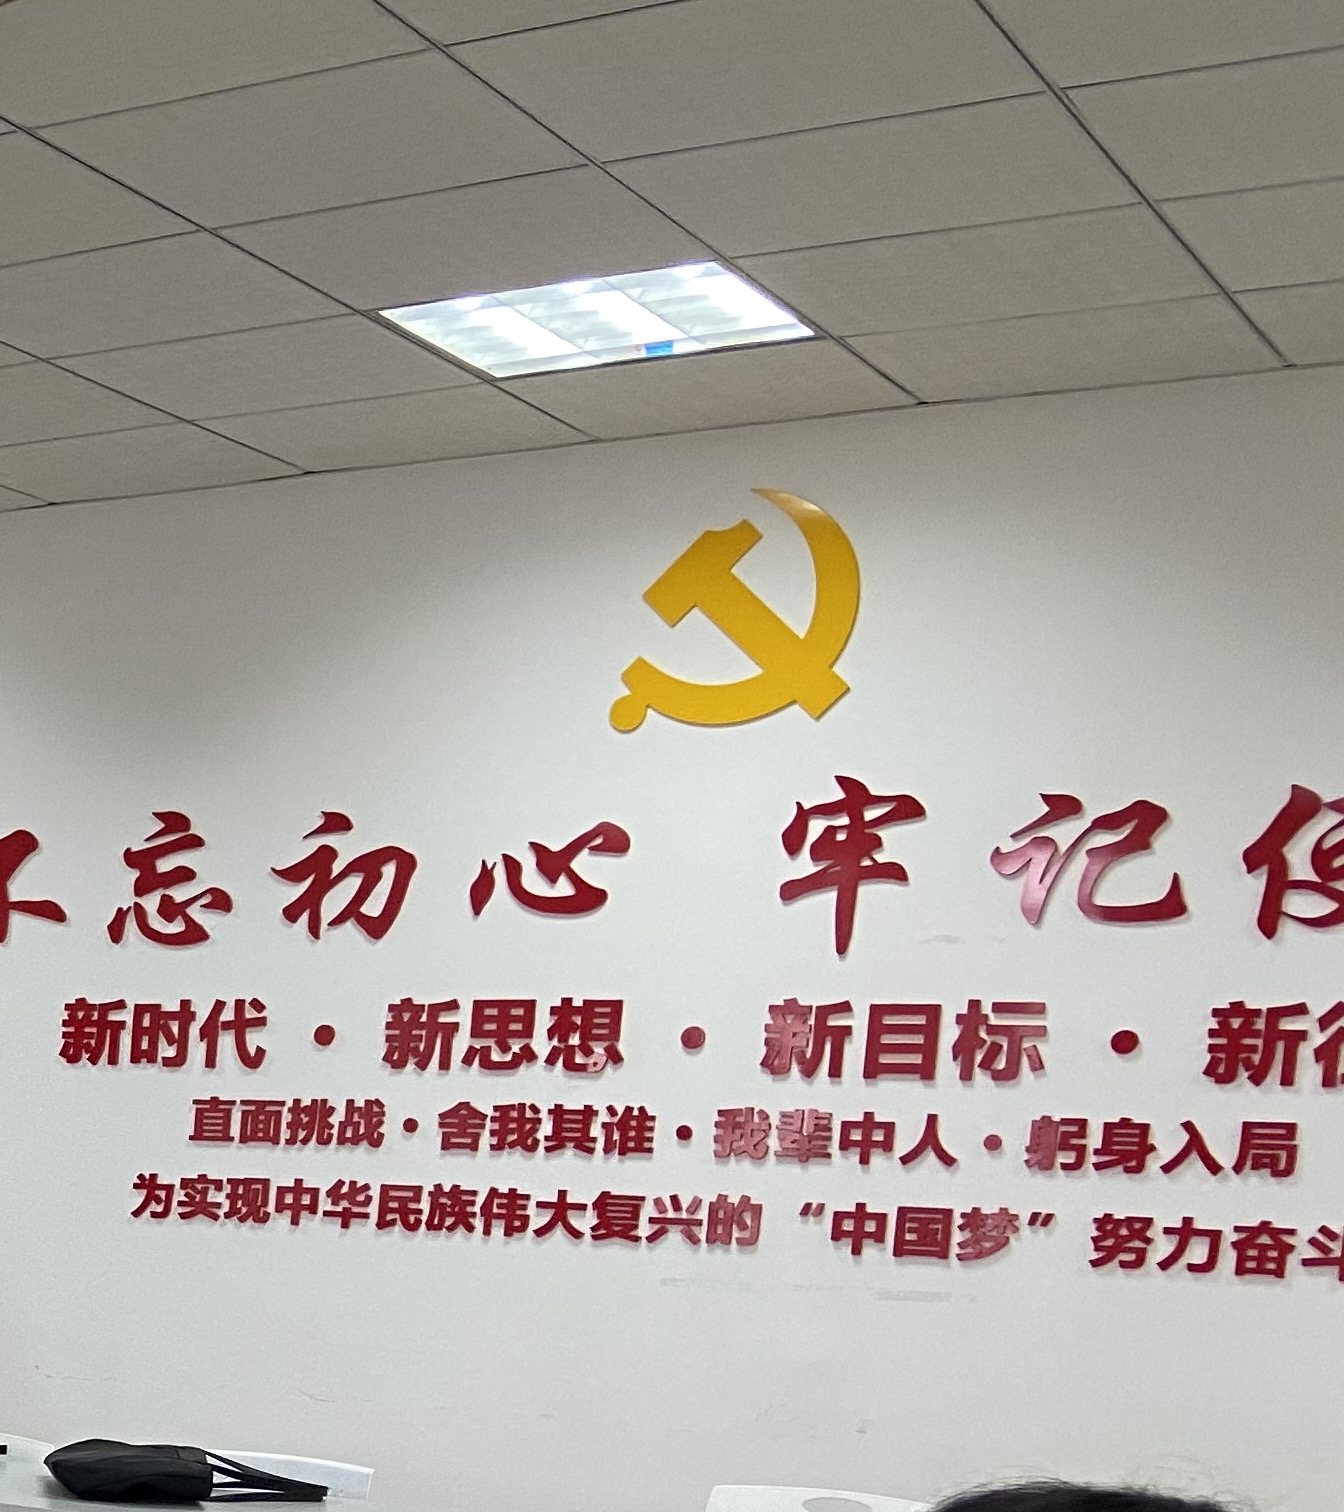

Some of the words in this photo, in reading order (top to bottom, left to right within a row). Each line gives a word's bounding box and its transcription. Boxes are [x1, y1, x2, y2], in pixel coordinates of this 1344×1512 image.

[59, 997, 267, 1070] 新时代
[383, 997, 624, 1073] 新思想
[760, 998, 1048, 1082] 新目标
